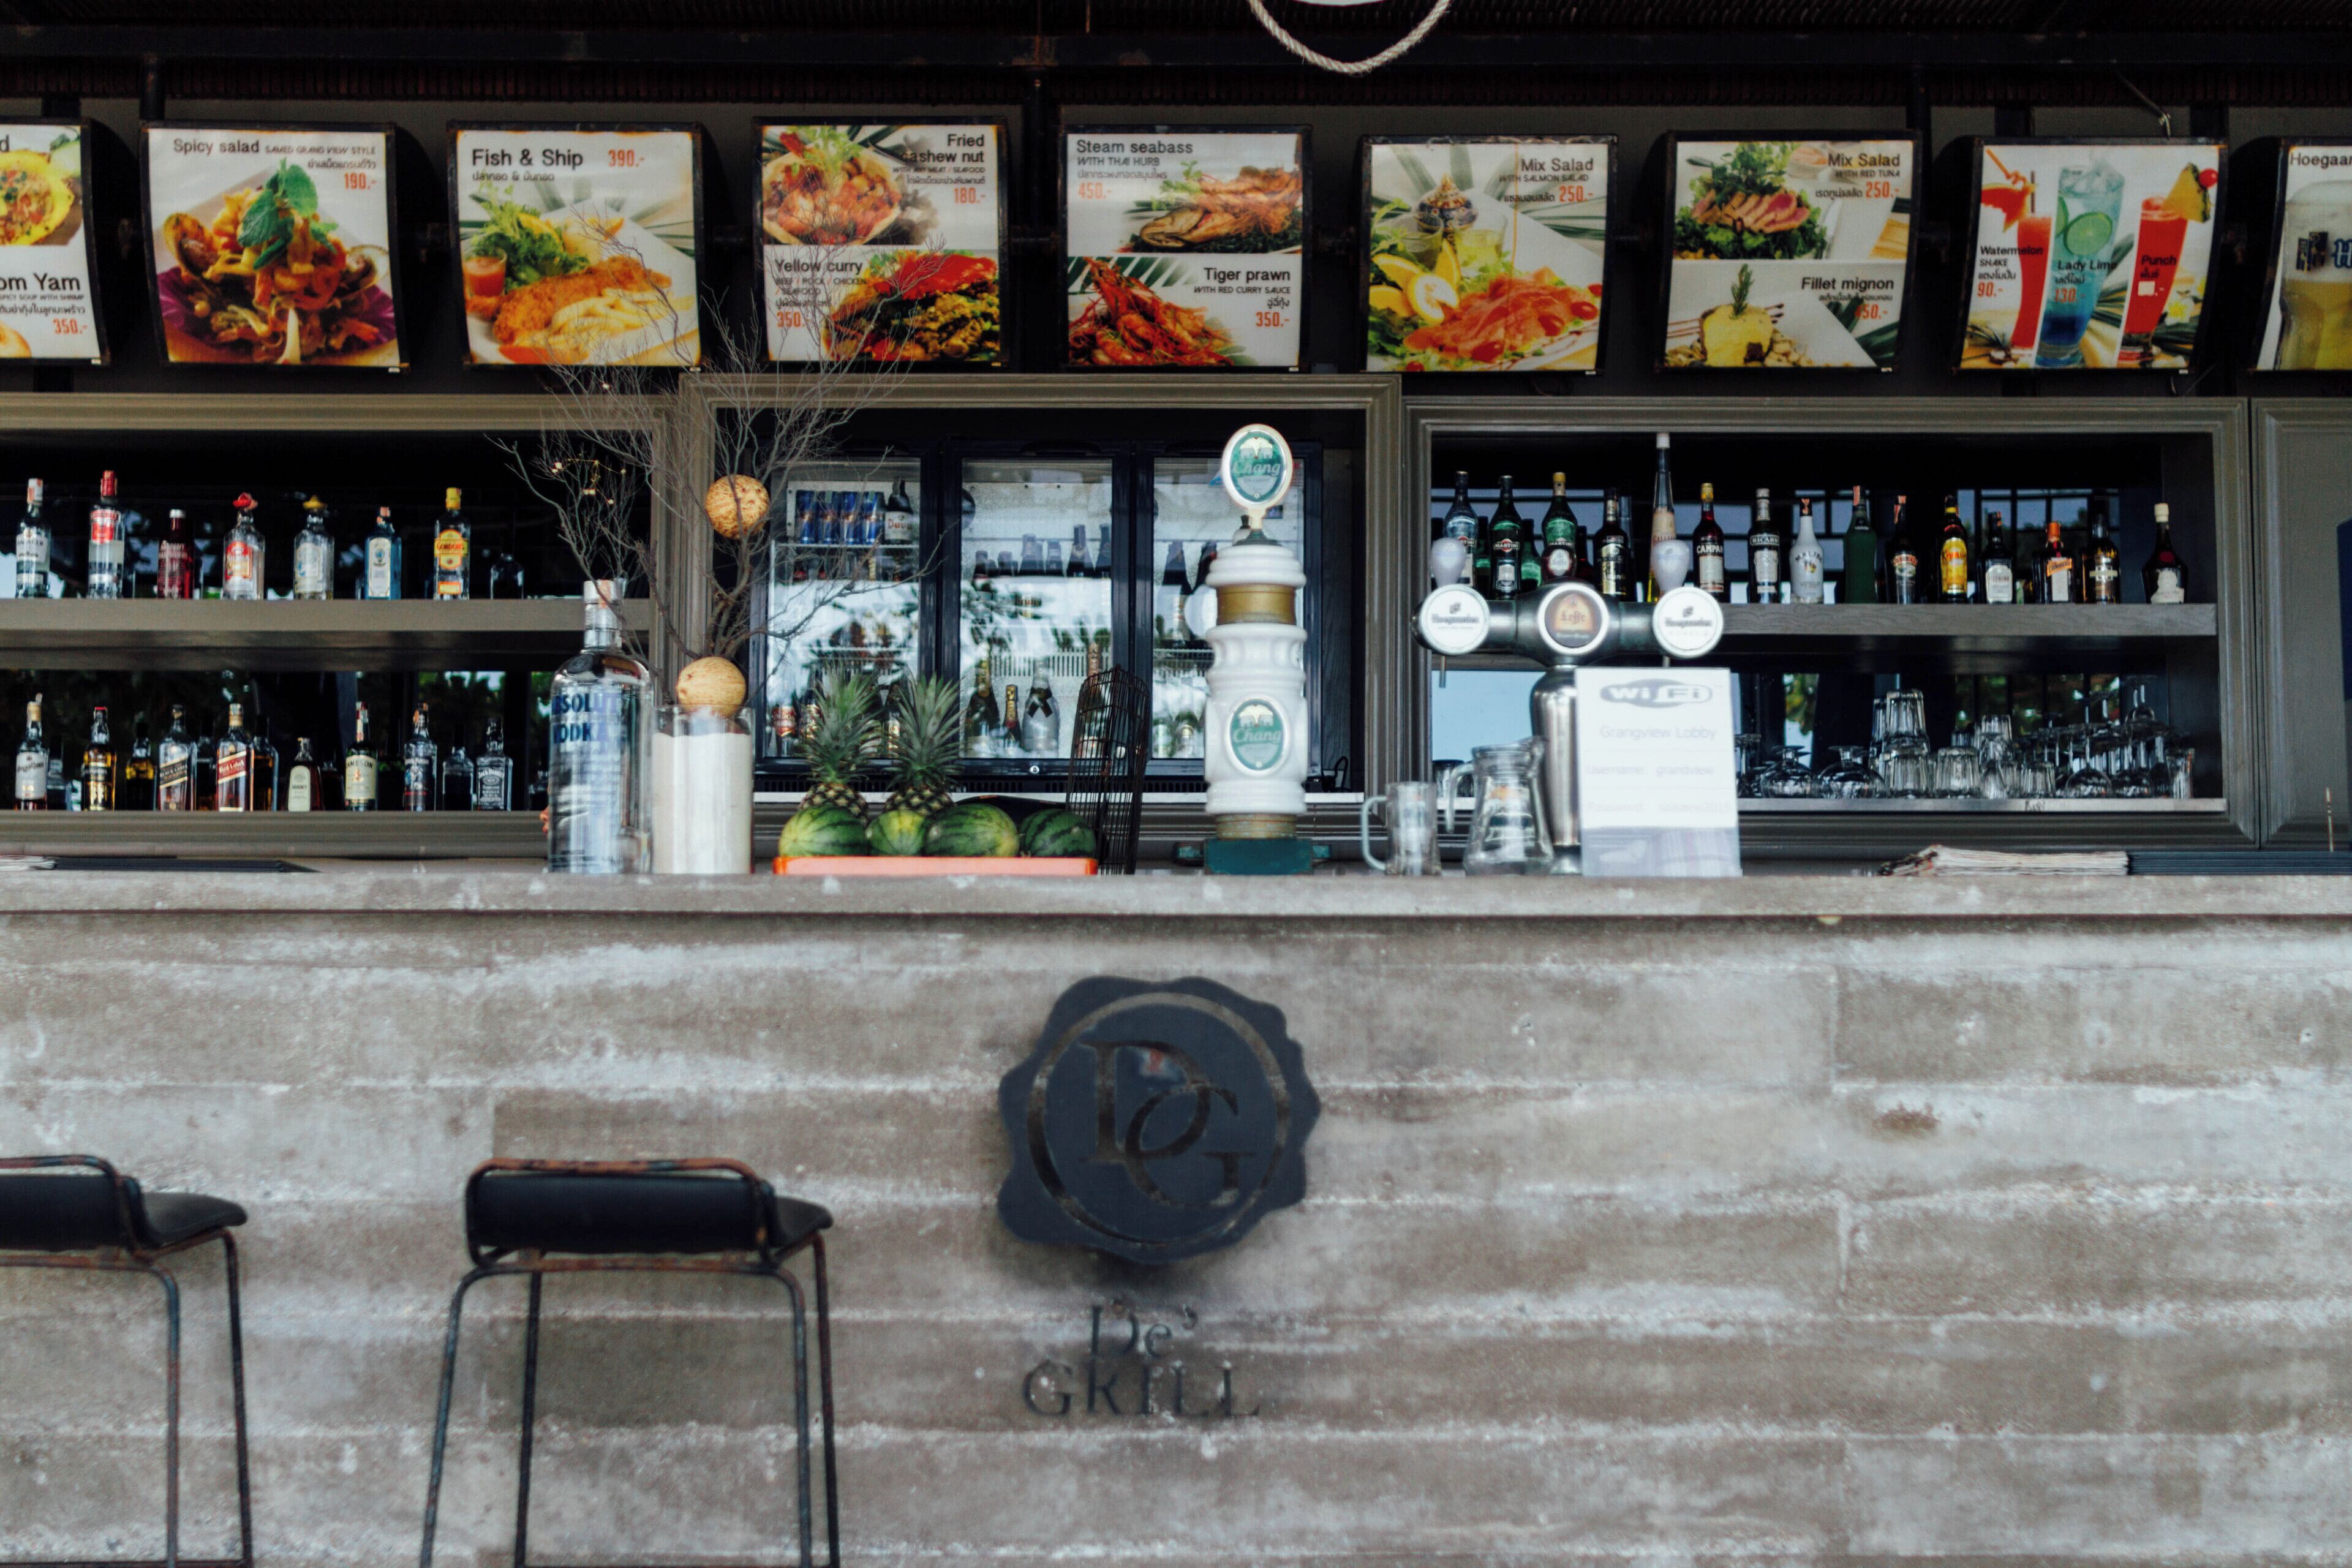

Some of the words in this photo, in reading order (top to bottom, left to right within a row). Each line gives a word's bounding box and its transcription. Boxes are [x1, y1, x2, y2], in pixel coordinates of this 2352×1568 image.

[173, 138, 213, 156] Spicy
[220, 140, 260, 153] salad
[326, 146, 349, 154] VIEW
[351, 146, 376, 155] STYLE
[948, 134, 985, 147] Fried
[1077, 138, 1125, 153] Steam
[1130, 140, 1194, 154] seabass
[472, 148, 512, 167] Fish
[519, 149, 533, 167] &
[541, 149, 584, 171] Ship
[608, 149, 646, 168] 390.-
[902, 149, 957, 163] cashew
[962, 151, 984, 163] nut
[1077, 156, 1104, 166] WITH
[1108, 157, 1131, 166] THAI
[1133, 157, 1160, 166] HURB
[1828, 153, 1853, 167] Mix
[1858, 153, 1901, 167] Salad
[1521, 158, 1547, 172] Mix
[1551, 157, 1594, 172] Salad
[344, 172, 377, 190] 190.-
[511, 170, 519, 182] &
[954, 187, 987, 204] 180.-
[1078, 181, 1113, 200] 450.-
[1559, 185, 1594, 203] 250.-
[1865, 181, 1900, 199] 250.-
[1980, 246, 2043, 255] Watermelon
[775, 258, 821, 273] Yellow
[827, 262, 862, 275] curry
[1980, 258, 2008, 267] SHAKE
[2057, 260, 2086, 272] Lady
[2089, 260, 2118, 271] Lime
[2141, 255, 2177, 265] Punch
[33, 273, 80, 291] Yam
[1204, 266, 1241, 284] Tiger
[1246, 270, 1291, 284] prawn
[1801, 277, 1836, 290] Fillet
[1841, 277, 1894, 292] mignon
[1977, 281, 2004, 298] 90.-
[2054, 287, 2086, 303] 130.-
[53, 318, 88, 335] 350.-
[1255, 311, 1290, 327] 350.-
[1233, 461, 1281, 477] Chang
[1675, 725, 1716, 741] Lobby
